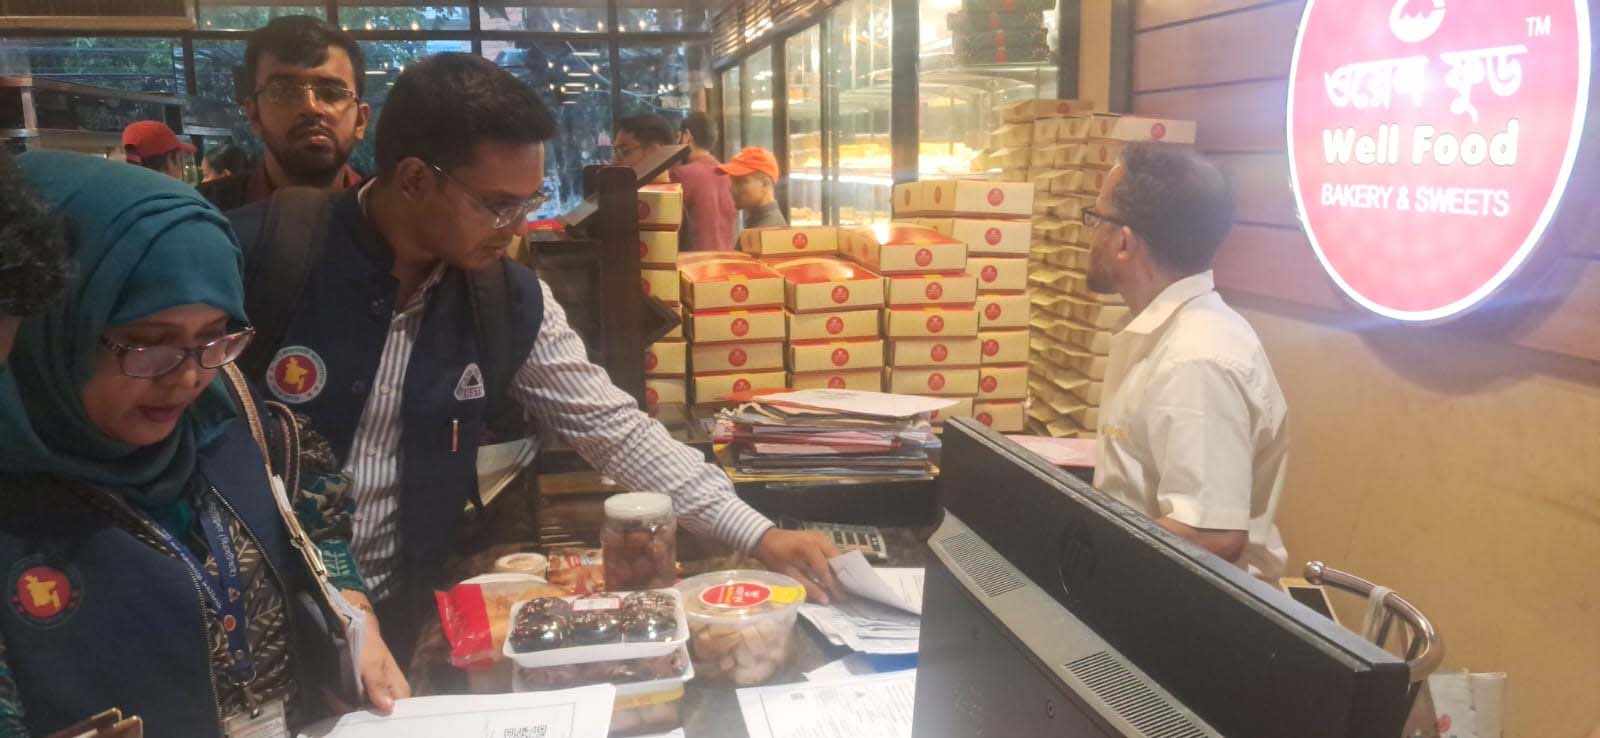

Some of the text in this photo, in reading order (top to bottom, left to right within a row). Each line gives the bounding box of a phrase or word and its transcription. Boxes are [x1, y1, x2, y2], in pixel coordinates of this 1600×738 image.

[1525, 15, 1552, 37] TM
[1440, 45, 1528, 124] ফুড
[1323, 118, 1520, 166] Well Food
[1322, 183, 1510, 217] BAKERY & SWEETS
